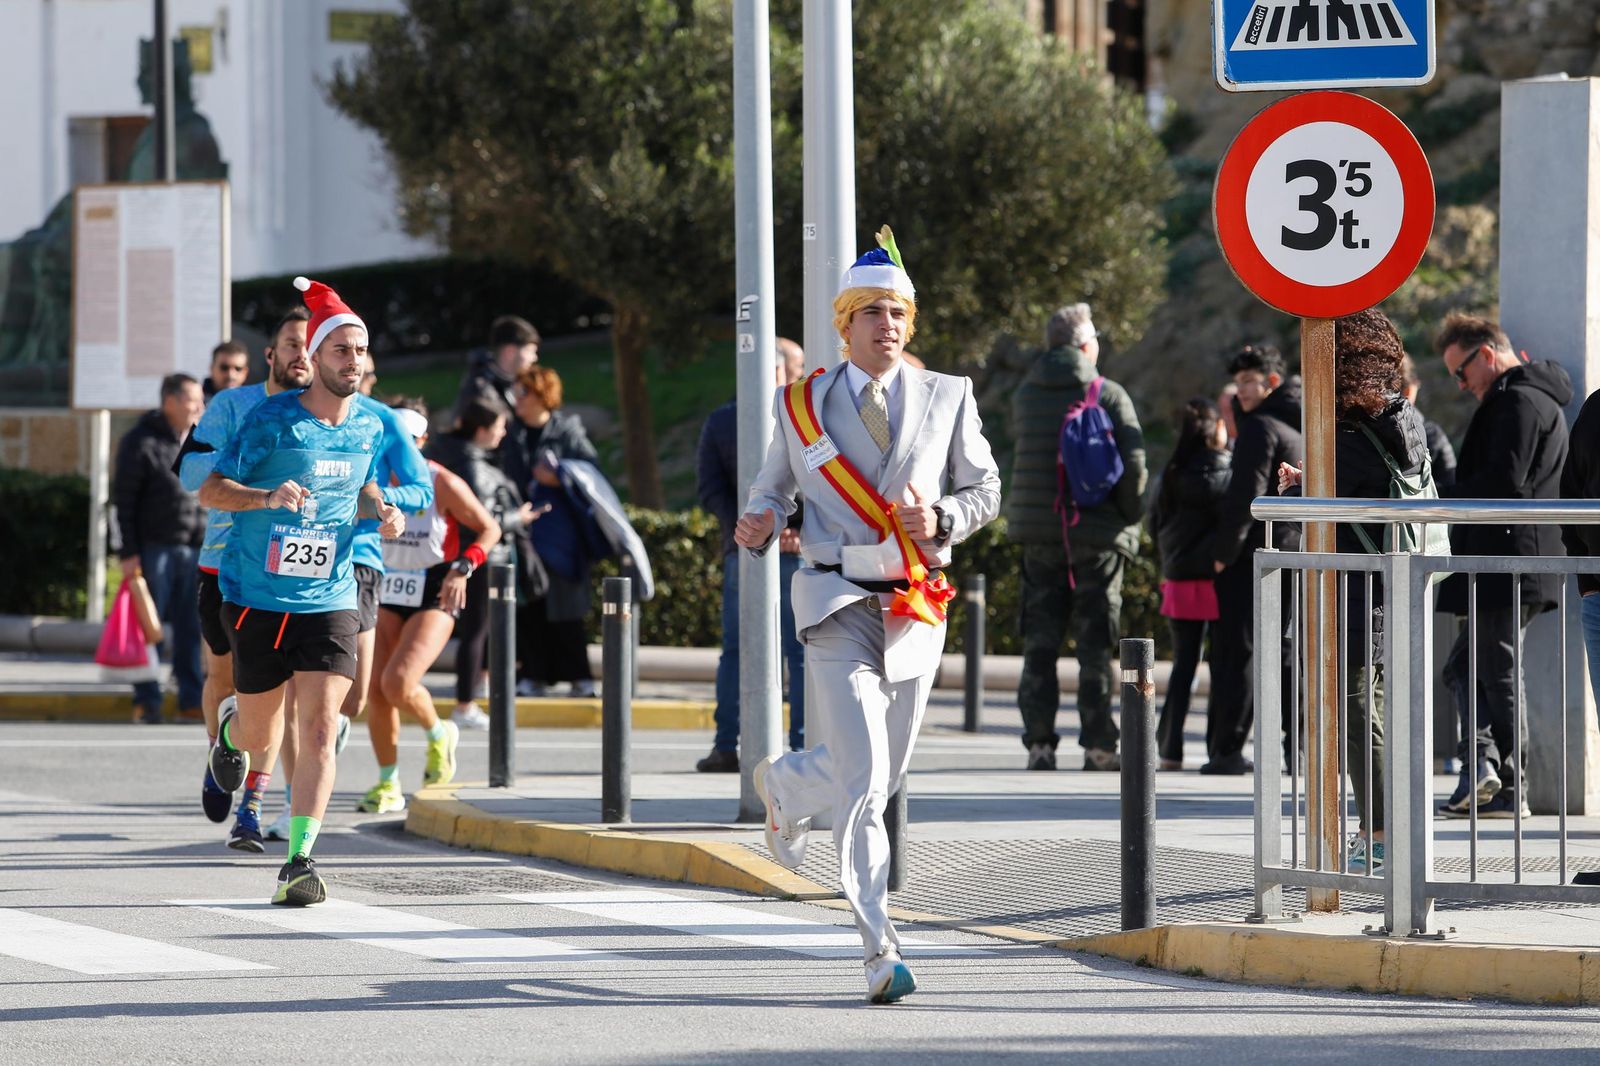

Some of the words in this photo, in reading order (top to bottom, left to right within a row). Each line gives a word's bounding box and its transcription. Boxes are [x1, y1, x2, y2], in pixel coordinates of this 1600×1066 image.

[1281, 159, 1337, 250] 3
[1339, 209, 1370, 249] t.
[289, 527, 337, 540] CARRERA
[283, 542, 328, 567] 235
[385, 577, 417, 596] 196
